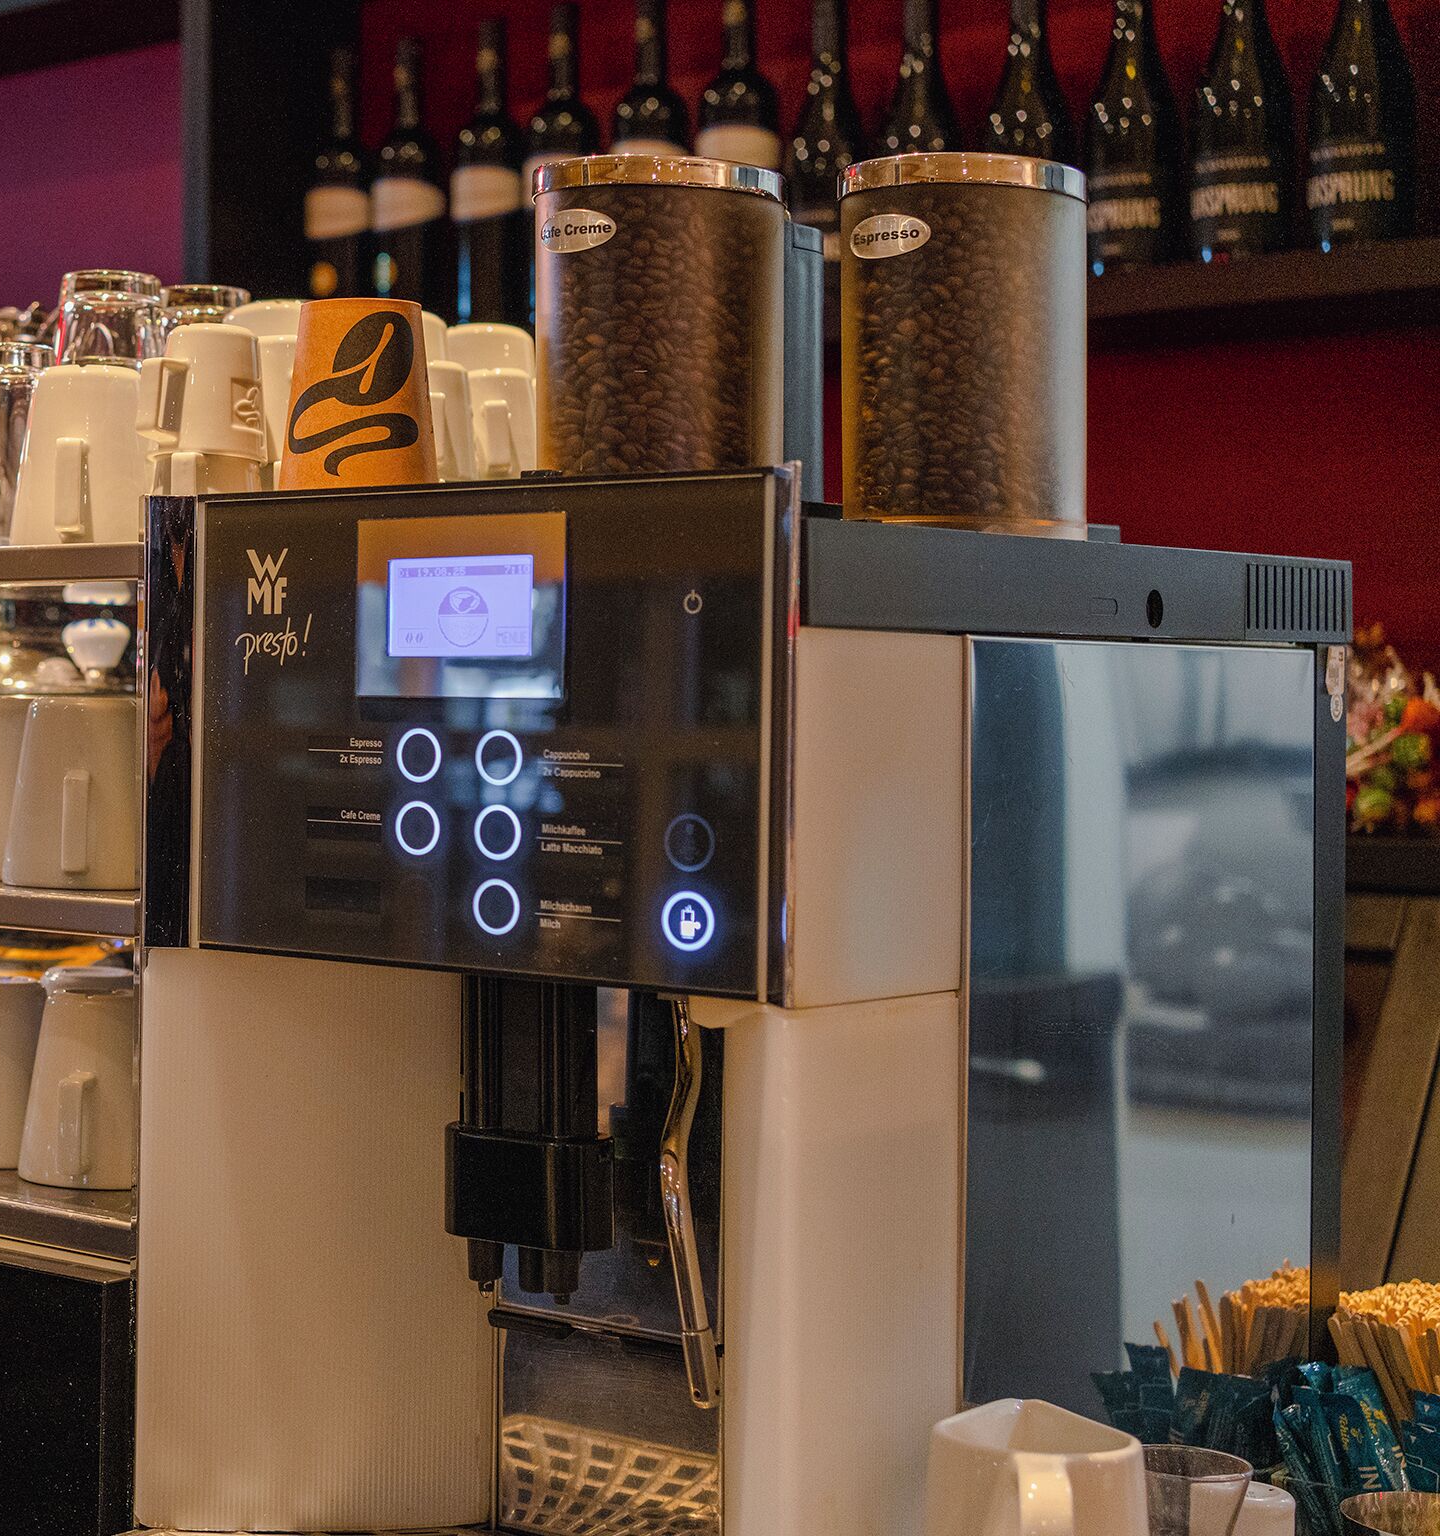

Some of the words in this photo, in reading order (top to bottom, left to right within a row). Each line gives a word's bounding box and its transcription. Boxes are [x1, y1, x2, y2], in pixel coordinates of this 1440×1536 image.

[564, 223, 612, 236] Creme
[853, 228, 920, 246] Espresso
[246, 548, 289, 615] WMF
[235, 613, 313, 676] presto!
[349, 737, 383, 749] Espresso
[339, 754, 349, 764] 2x
[349, 754, 382, 766] Espresso
[543, 748, 591, 761] Cappuccino
[543, 767, 553, 777] 2x
[554, 767, 601, 779] Cappuccino
[340, 809, 357, 820] Cafe
[358, 810, 381, 821] Creme
[541, 823, 586, 836] Milchkaffee
[541, 841, 561, 853] Latte
[562, 843, 603, 856] Macchiato
[540, 899, 593, 914] Milchschaum
[539, 918, 561, 929] Milch
